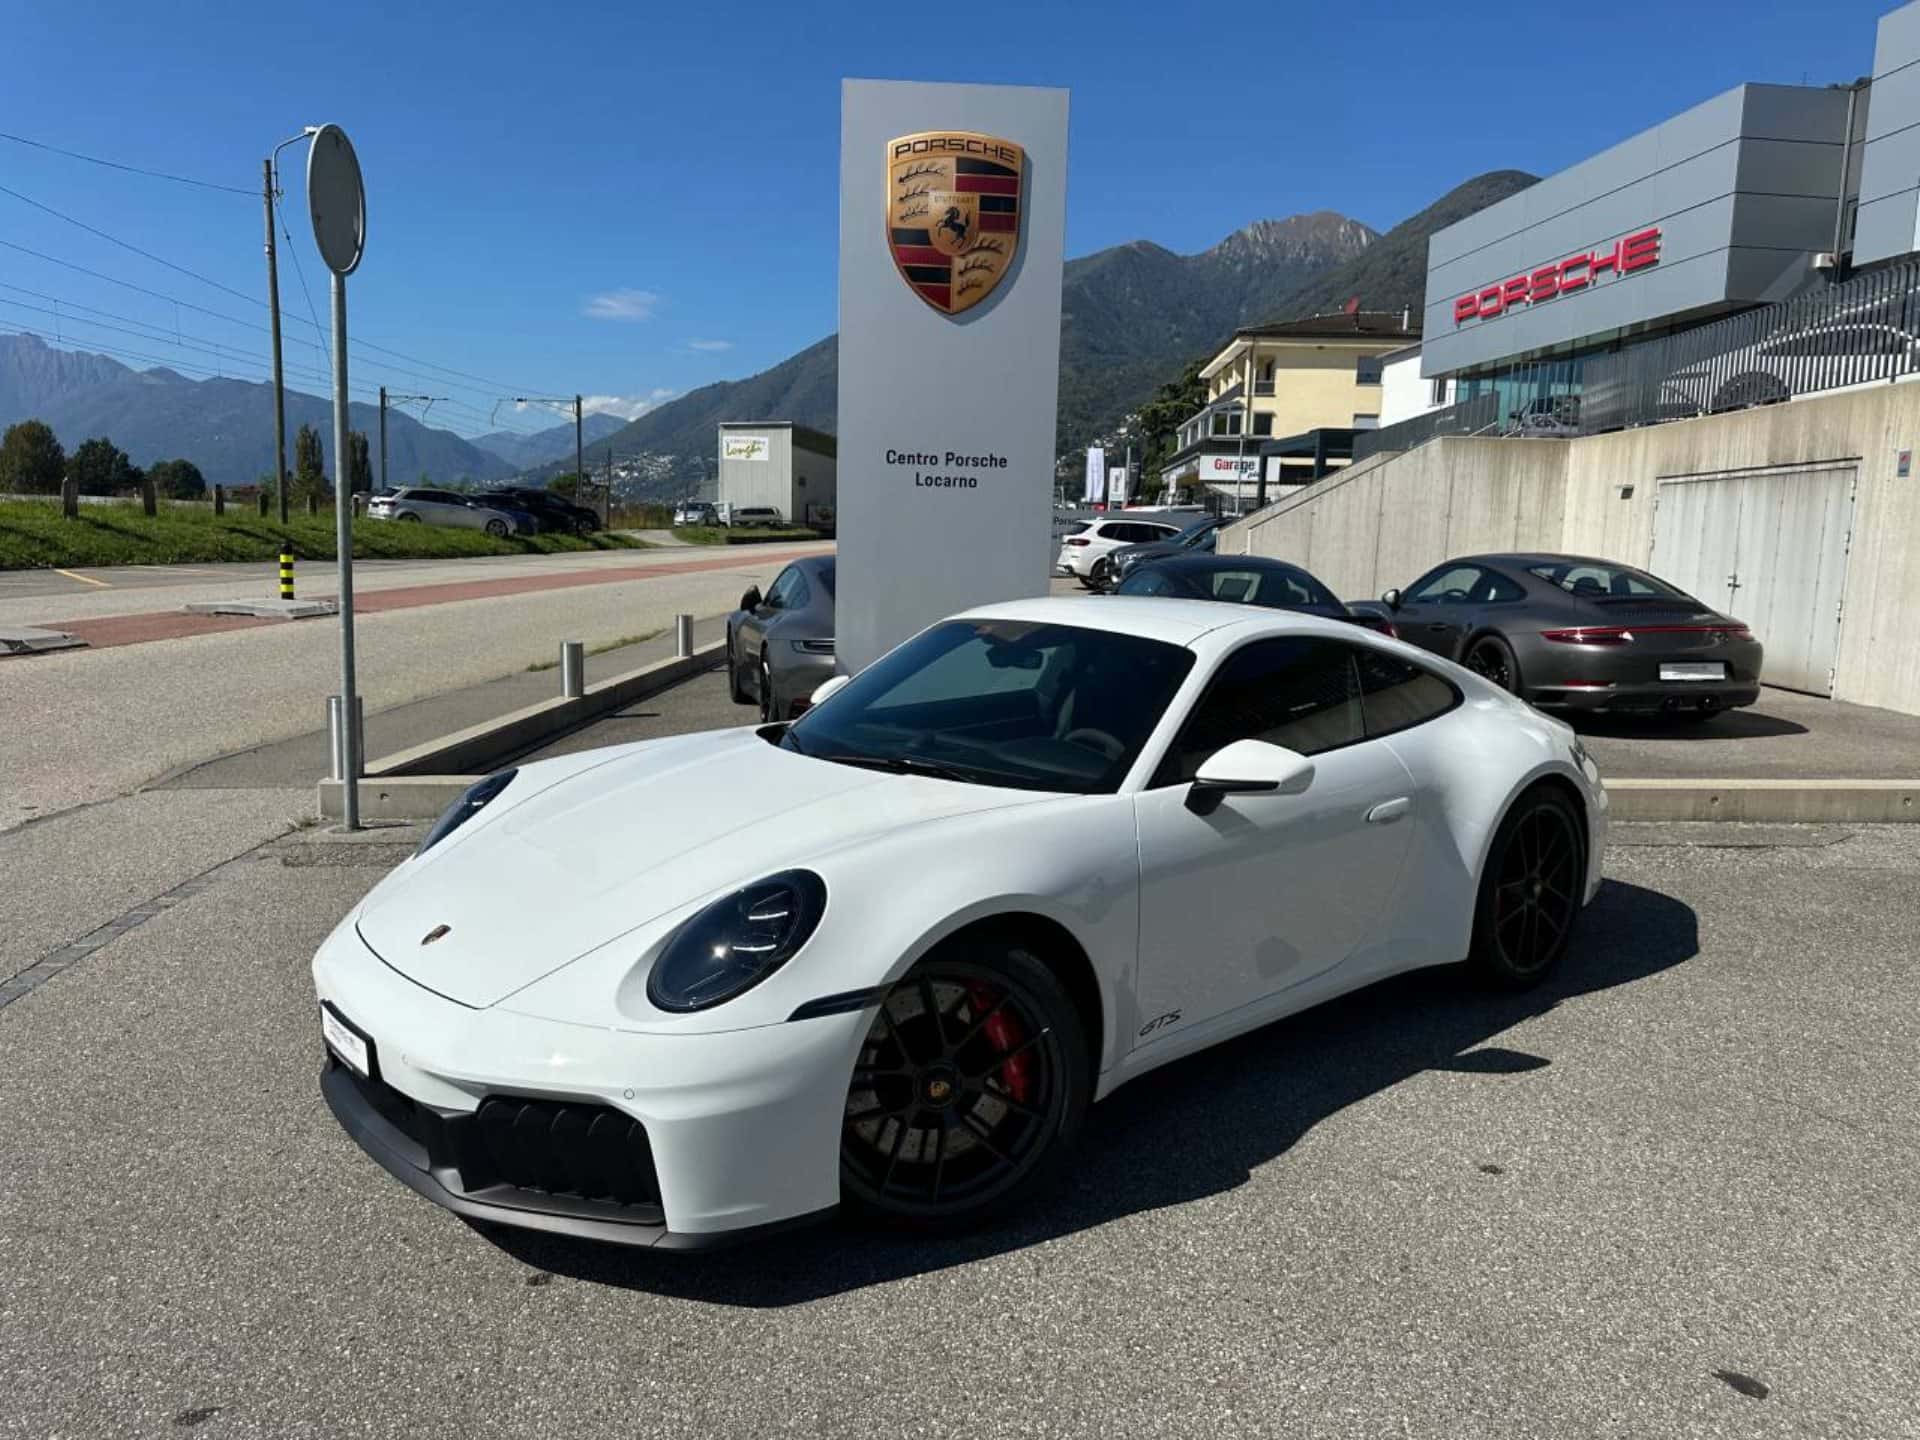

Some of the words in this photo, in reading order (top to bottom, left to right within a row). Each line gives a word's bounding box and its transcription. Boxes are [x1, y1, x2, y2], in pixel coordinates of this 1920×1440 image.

[895, 138, 1016, 164] PORSCHE
[1454, 227, 1662, 328] PORSCHE
[886, 449, 938, 466] Centro
[944, 451, 1008, 468] Porsche
[1214, 458, 1256, 473] Garage
[915, 471, 977, 488] Locarno
[1139, 1009, 1182, 1036] GTS
